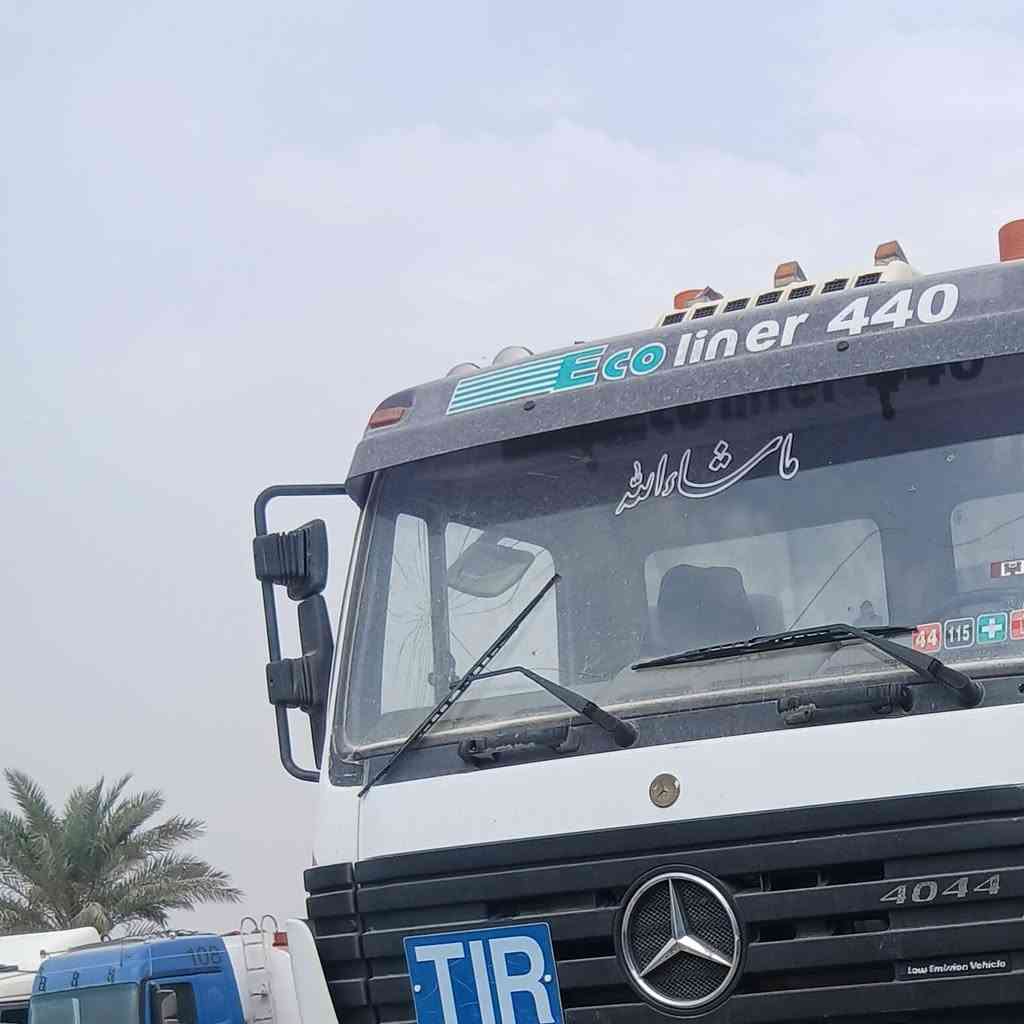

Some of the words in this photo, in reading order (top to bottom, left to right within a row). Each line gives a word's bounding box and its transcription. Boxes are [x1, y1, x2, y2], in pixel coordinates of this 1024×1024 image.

[551, 343, 667, 392] Eco
[673, 313, 810, 367] liner
[826, 283, 959, 335] 440
[949, 624, 971, 643] 115
[879, 873, 1000, 904] 4044
[907, 965, 928, 975] Low
